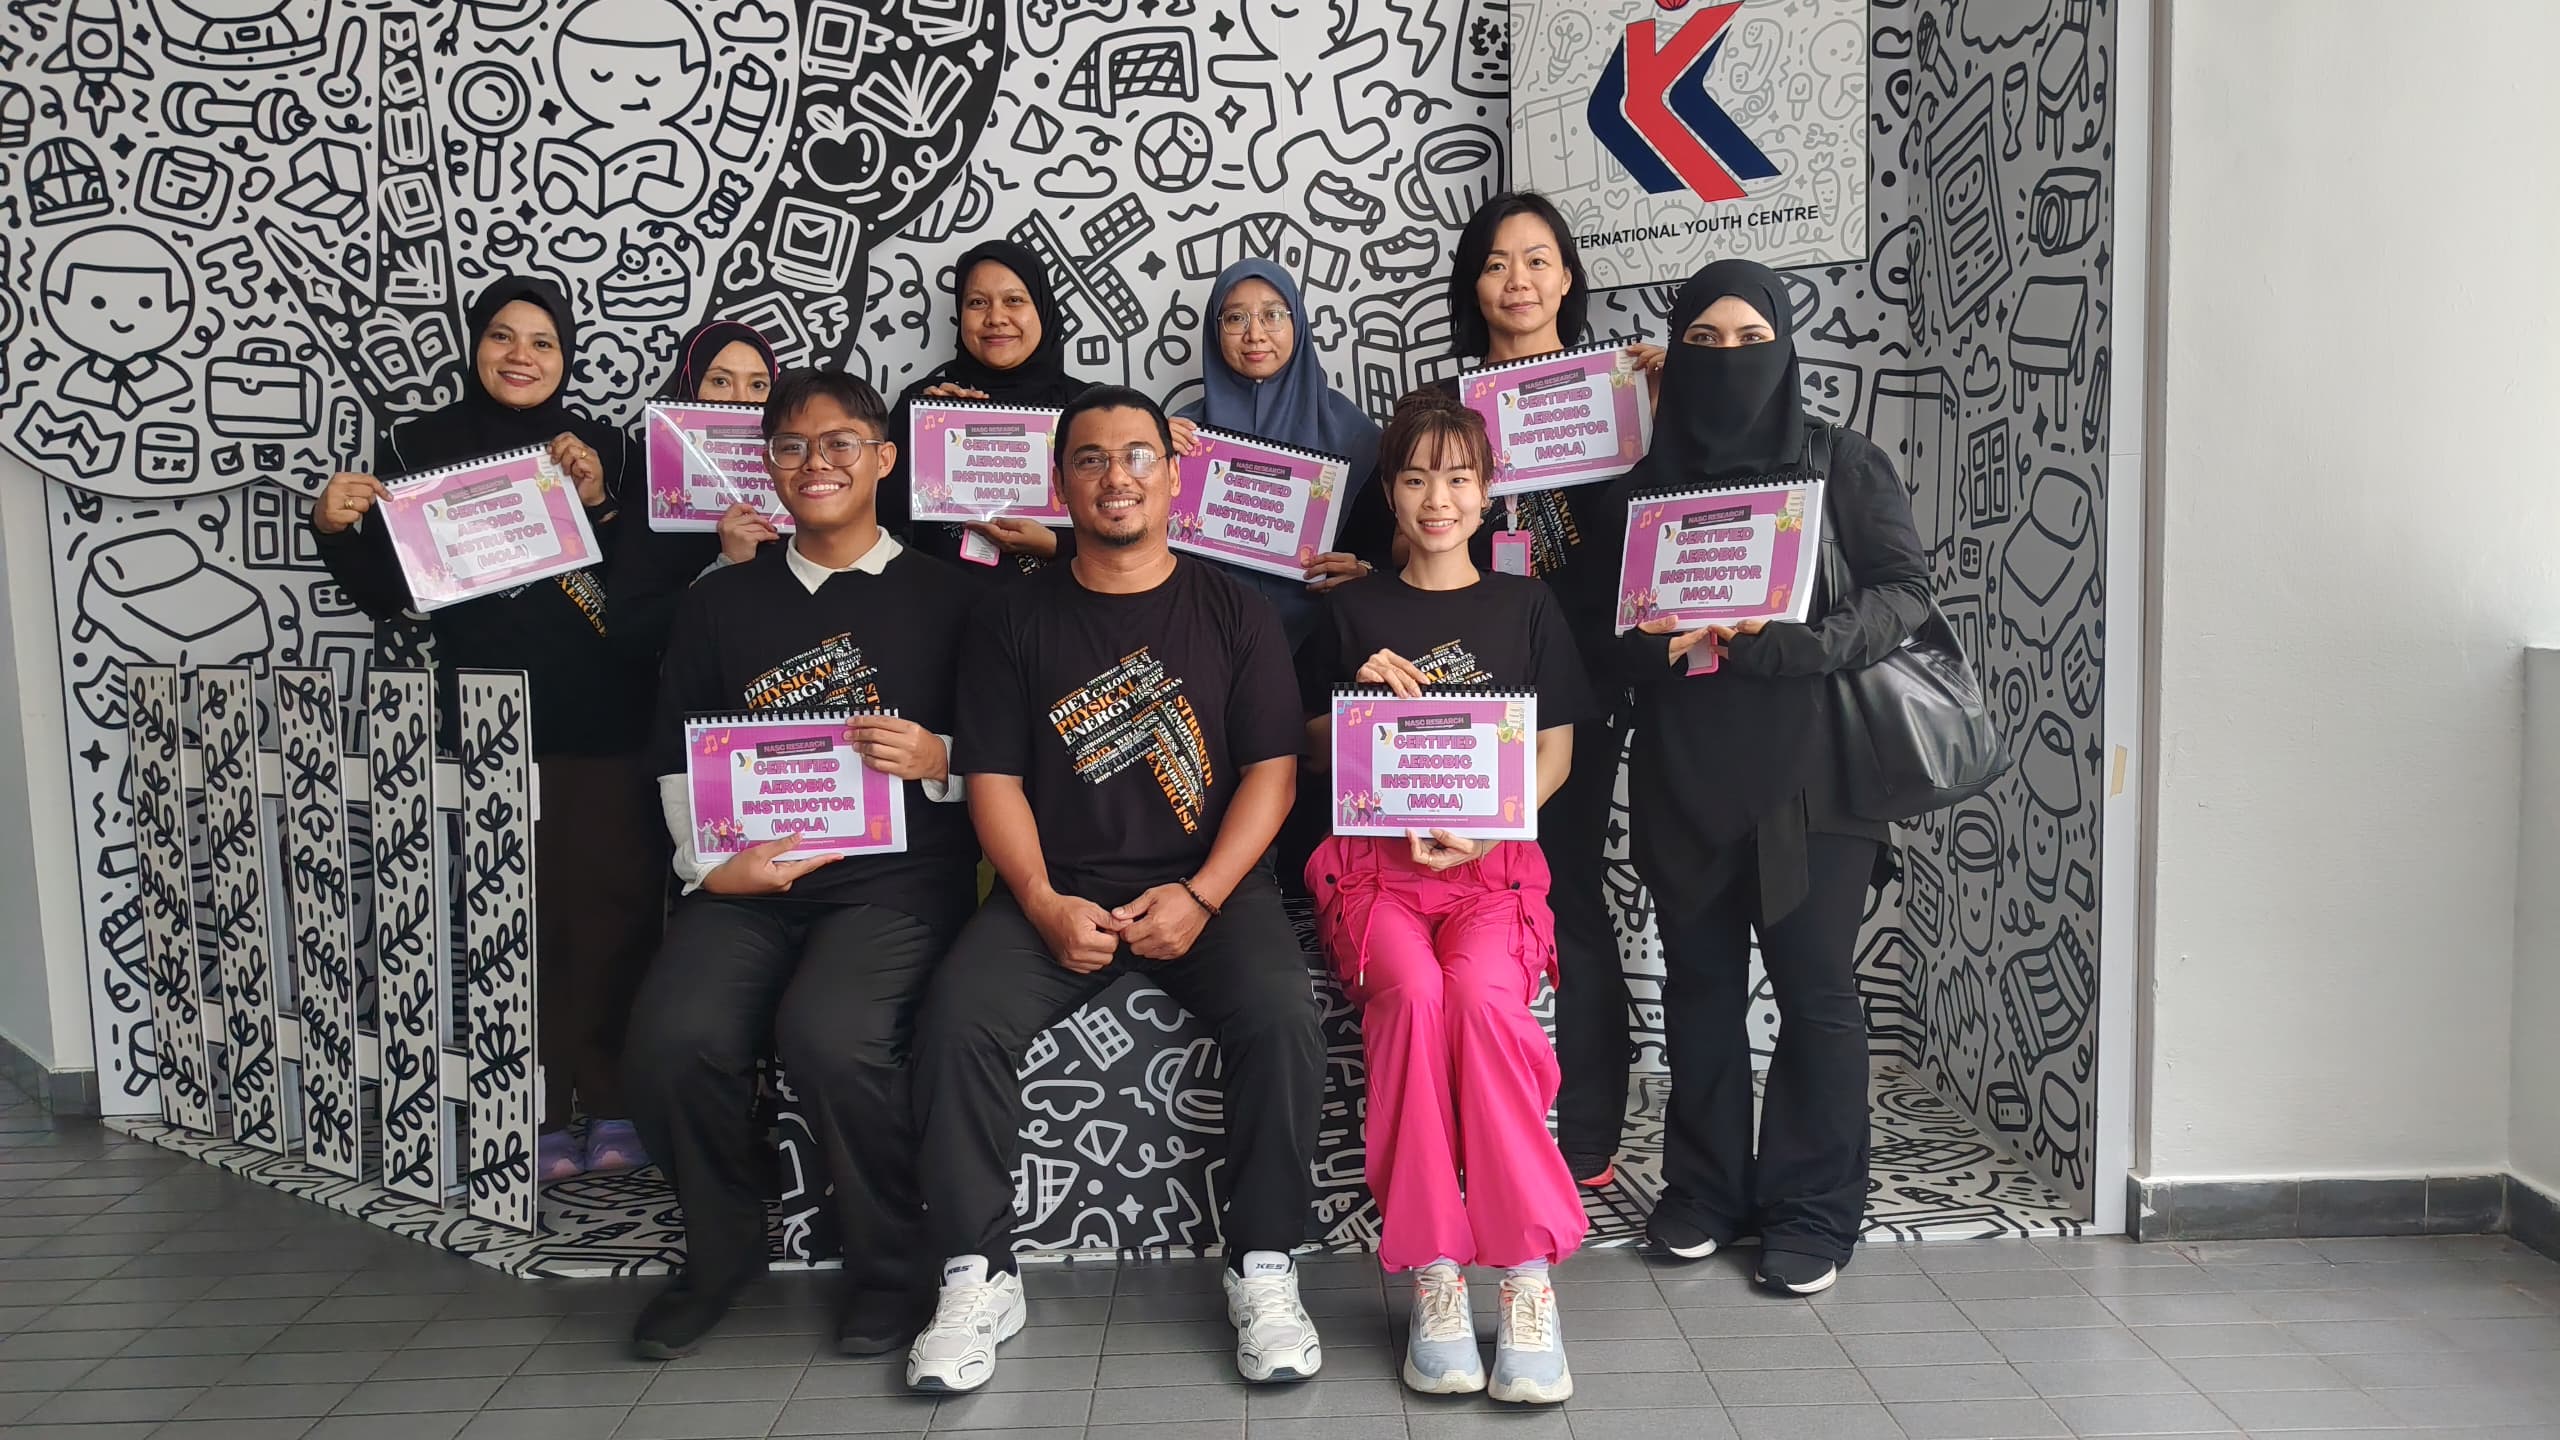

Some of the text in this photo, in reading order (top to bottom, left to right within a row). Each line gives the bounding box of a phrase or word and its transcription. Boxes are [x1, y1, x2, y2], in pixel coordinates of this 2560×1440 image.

[1573, 204, 1820, 250] TERNATIONAL YOUTH CENTRE
[1517, 387, 1592, 410] CERTIFIED
[1523, 404, 1591, 427] AEROBIC
[1509, 420, 1608, 446] INSTRUCTOR
[963, 438, 1030, 453] CERTIFIED
[1534, 441, 1586, 462] (MOLA)
[966, 455, 1027, 468] AEROBIC
[952, 470, 1041, 485] INSTRUCTOR
[1223, 472, 1292, 498] CERTIFIED
[974, 487, 1020, 502] (MOLA)
[1223, 490, 1284, 513] AEROBIC
[1206, 502, 1295, 534] INSTRUCTOR
[1223, 523, 1269, 547] (MOLA)
[1676, 526, 1754, 546] CERTIFIED
[1676, 546, 1747, 565] AEROBIC
[1659, 565, 1762, 585] INSTRUCTOR
[1679, 585, 1733, 605] (MOLA)
[1048, 689, 1092, 725] DIET
[1092, 662, 1145, 698] CALORIES
[1150, 677, 1183, 700] HUMAN
[1055, 679, 1138, 735] PHYSICAL
[1062, 696, 1131, 746] ENERGY
[1404, 717, 1464, 727] NASC RESEARCH
[763, 740, 825, 752] NASC RESEARCH
[1174, 695, 1213, 787] STRENGTH
[1393, 735, 1477, 750] CERTIFIED
[753, 758, 840, 775] CERTIFIED
[1094, 772, 1112, 784] BODY
[1113, 746, 1153, 773] ADAPTATION
[1397, 754, 1472, 769] AEROBIC
[1153, 742, 1193, 807] FLEXIBILITY
[1380, 774, 1490, 789] INSTRUCTOR
[760, 778, 836, 795] AEROBIC
[1146, 751, 1198, 834] EXERCISE
[742, 797, 855, 815] INSTRUCTOR
[1407, 793, 1463, 811] (MOLA)
[771, 816, 829, 835] (MOLA)
